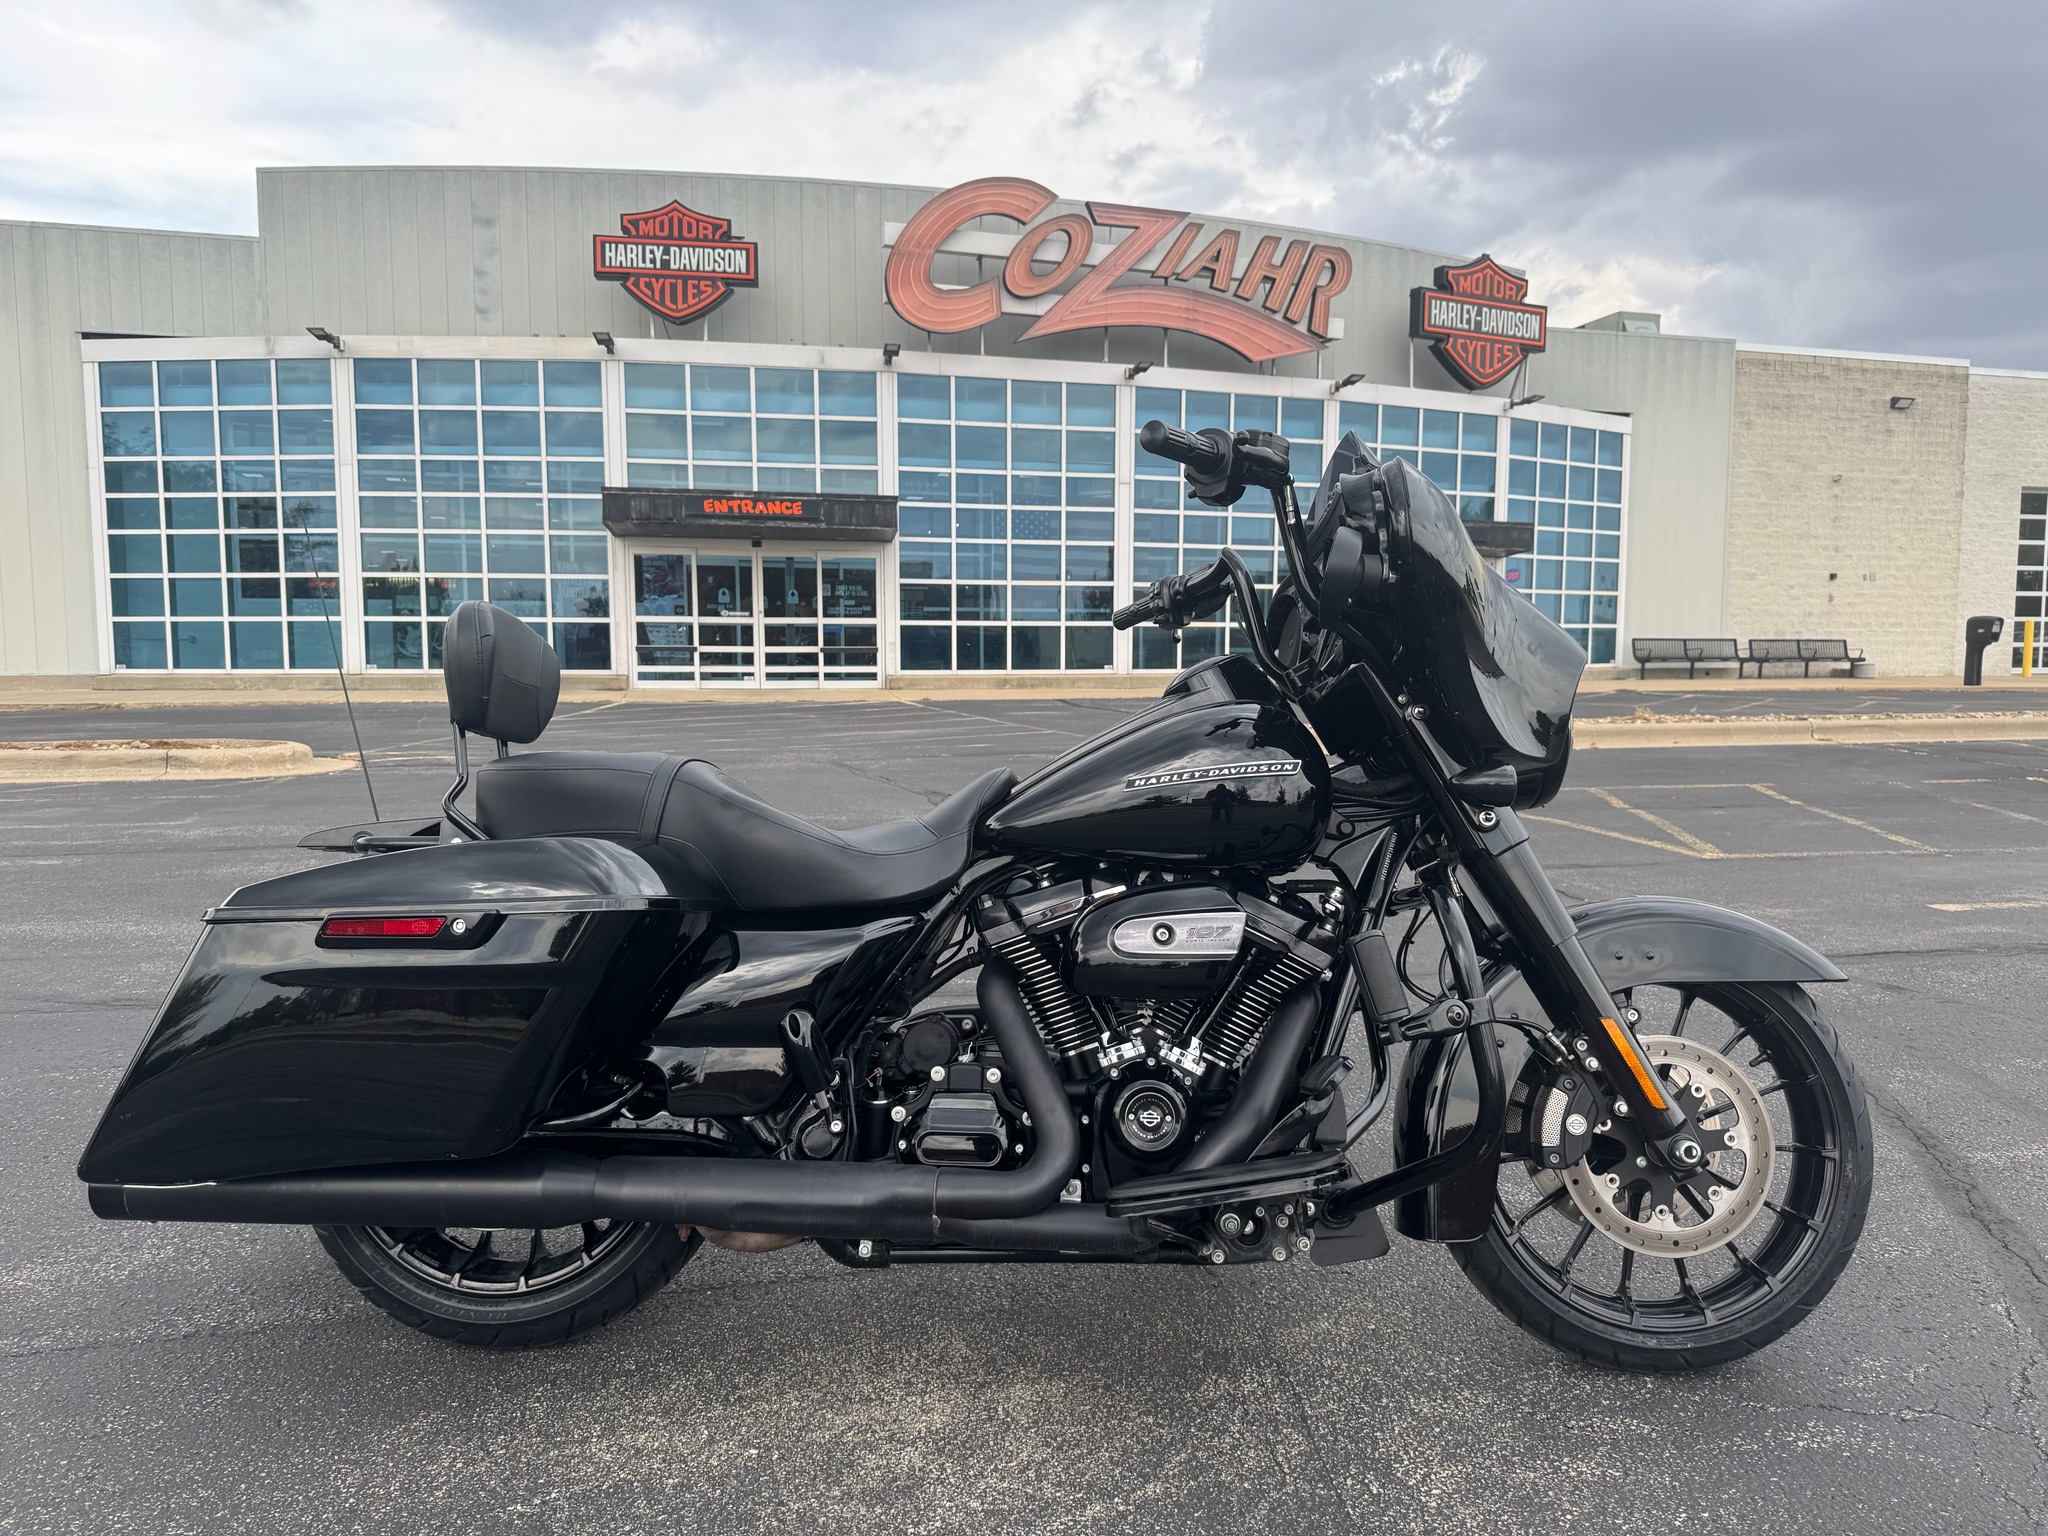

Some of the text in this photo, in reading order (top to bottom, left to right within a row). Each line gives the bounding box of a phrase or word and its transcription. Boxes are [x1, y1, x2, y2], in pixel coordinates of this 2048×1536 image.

[639, 211, 713, 240] MOTOR
[605, 243, 747, 273] HARLEY-DAVIDSON
[639, 277, 713, 310] CYCLES
[1459, 268, 1516, 300] MOTOR
[1431, 299, 1540, 340] HARLEY-DAVIDSON
[1456, 339, 1513, 374] CYCLES
[703, 498, 803, 515] ENTRANCE
[1134, 764, 1294, 786] HARLEY-DAVIDSON
[1186, 924, 1233, 939] 107
